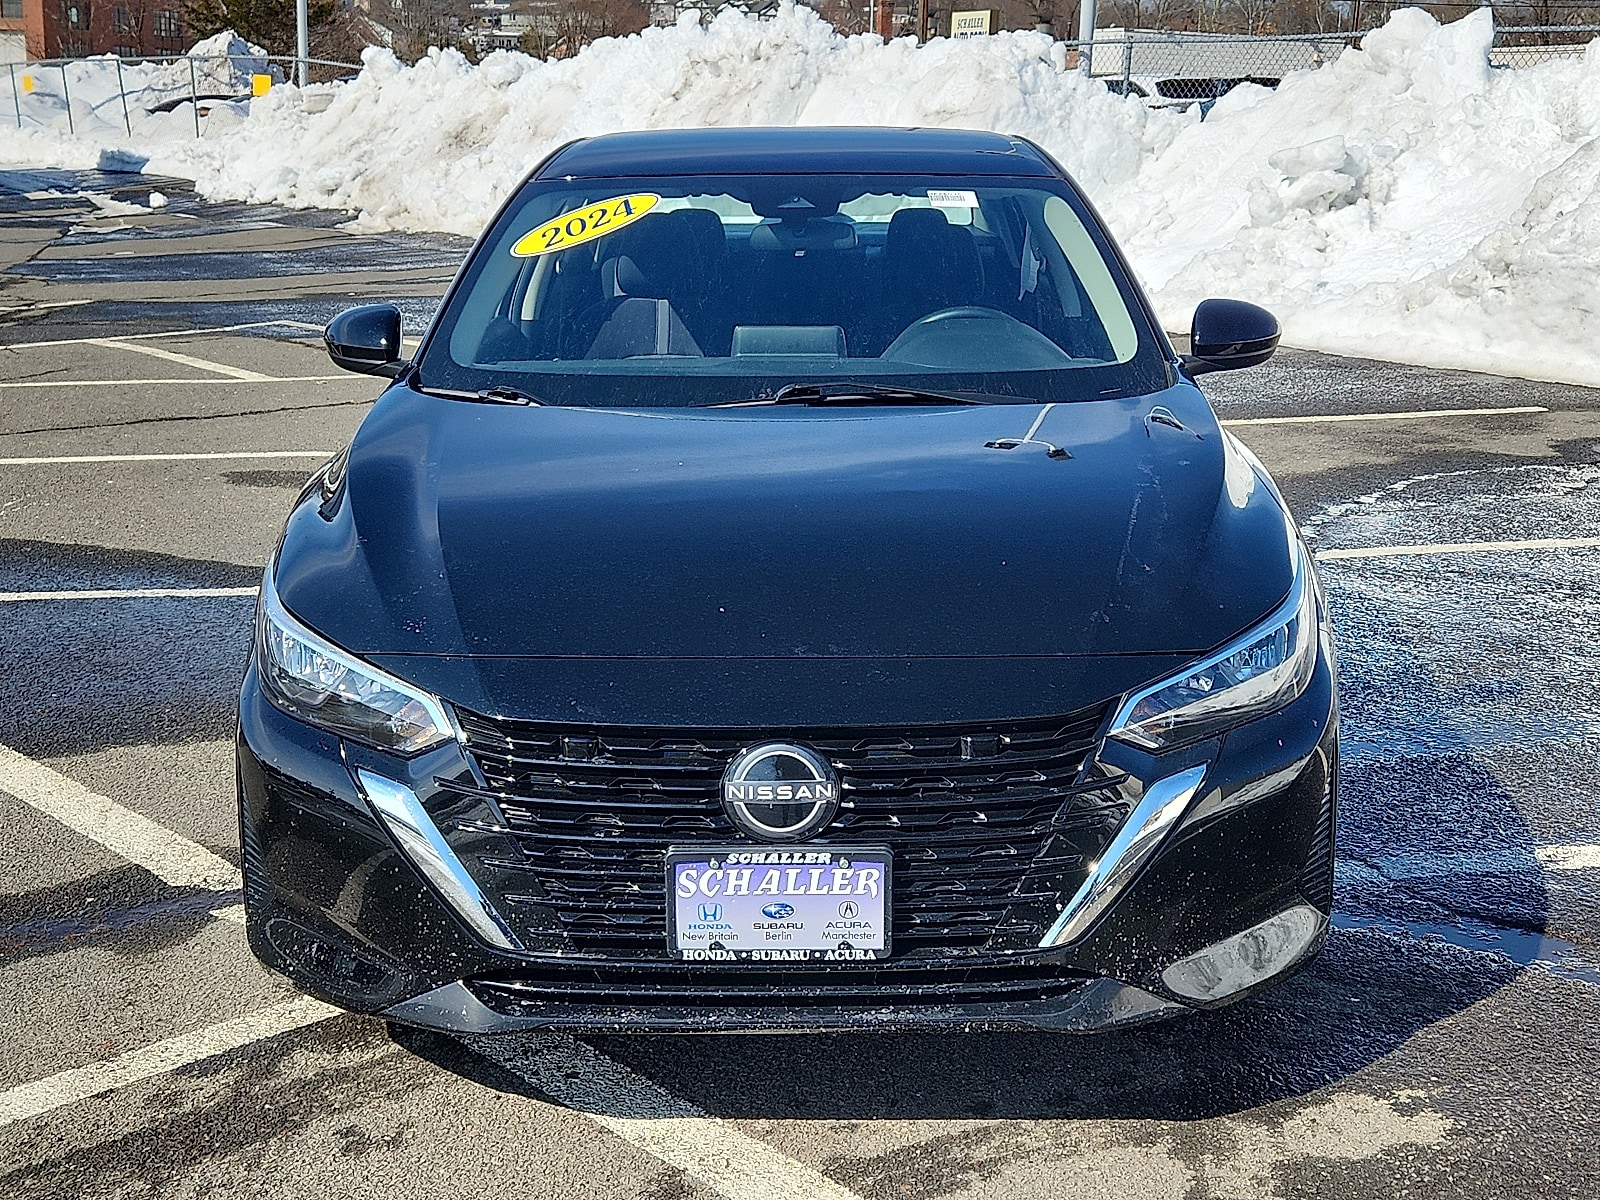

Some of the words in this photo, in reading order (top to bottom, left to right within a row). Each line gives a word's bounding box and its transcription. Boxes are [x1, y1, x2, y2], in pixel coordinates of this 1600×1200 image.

[541, 198, 637, 248] 2024
[728, 783, 834, 800] NISSAN
[726, 853, 831, 865] SCHALLER
[677, 868, 881, 899] SCHALLER
[753, 922, 804, 930] SUBARU
[825, 921, 872, 929] ACURA
[682, 932, 705, 941] New
[708, 932, 738, 941] Britain
[765, 931, 792, 941] Berlin
[822, 931, 876, 940] Manchester
[682, 950, 737, 961] HONDA
[751, 950, 810, 961] SUBARU
[824, 950, 876, 961] ACURA
